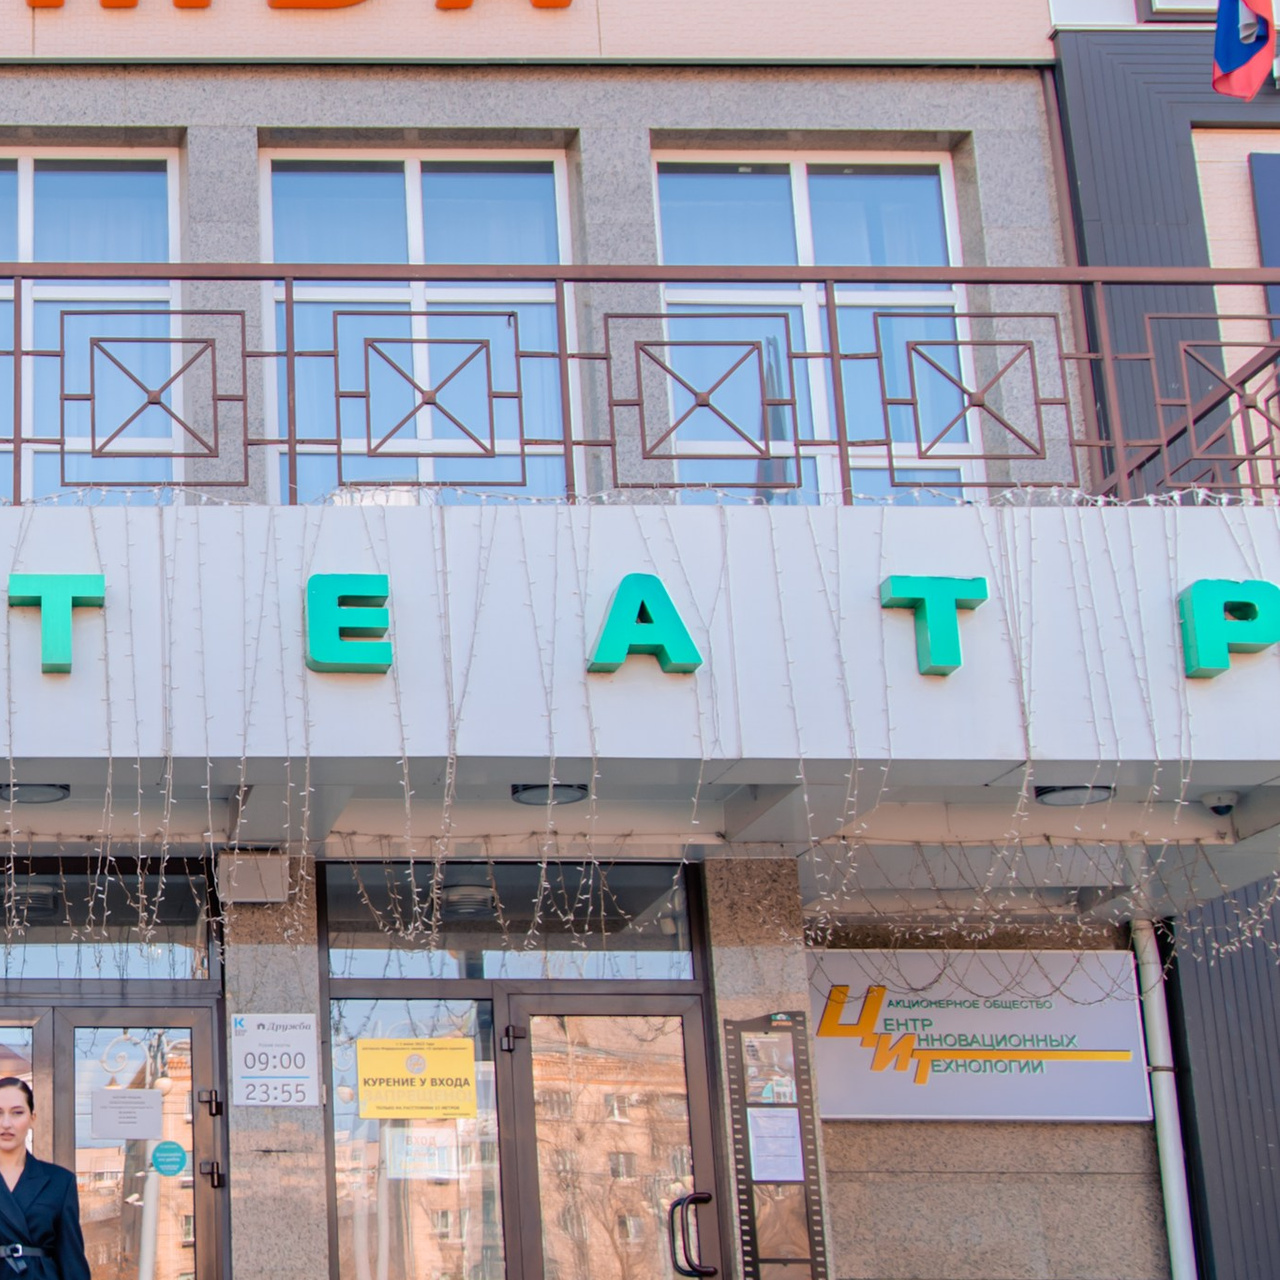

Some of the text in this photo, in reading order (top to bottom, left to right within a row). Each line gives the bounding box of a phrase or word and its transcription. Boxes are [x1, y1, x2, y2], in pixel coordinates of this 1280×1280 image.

[887, 999, 1053, 1011] АКЦИОНЕРНОЕ ОБЩЕСТВО
[266, 1022, 312, 1032] Дружба
[244, 1051, 306, 1072] 09:00
[363, 1077, 471, 1088] КУРЕНИЕ У ВХОДА
[245, 1083, 307, 1103] 23:55
